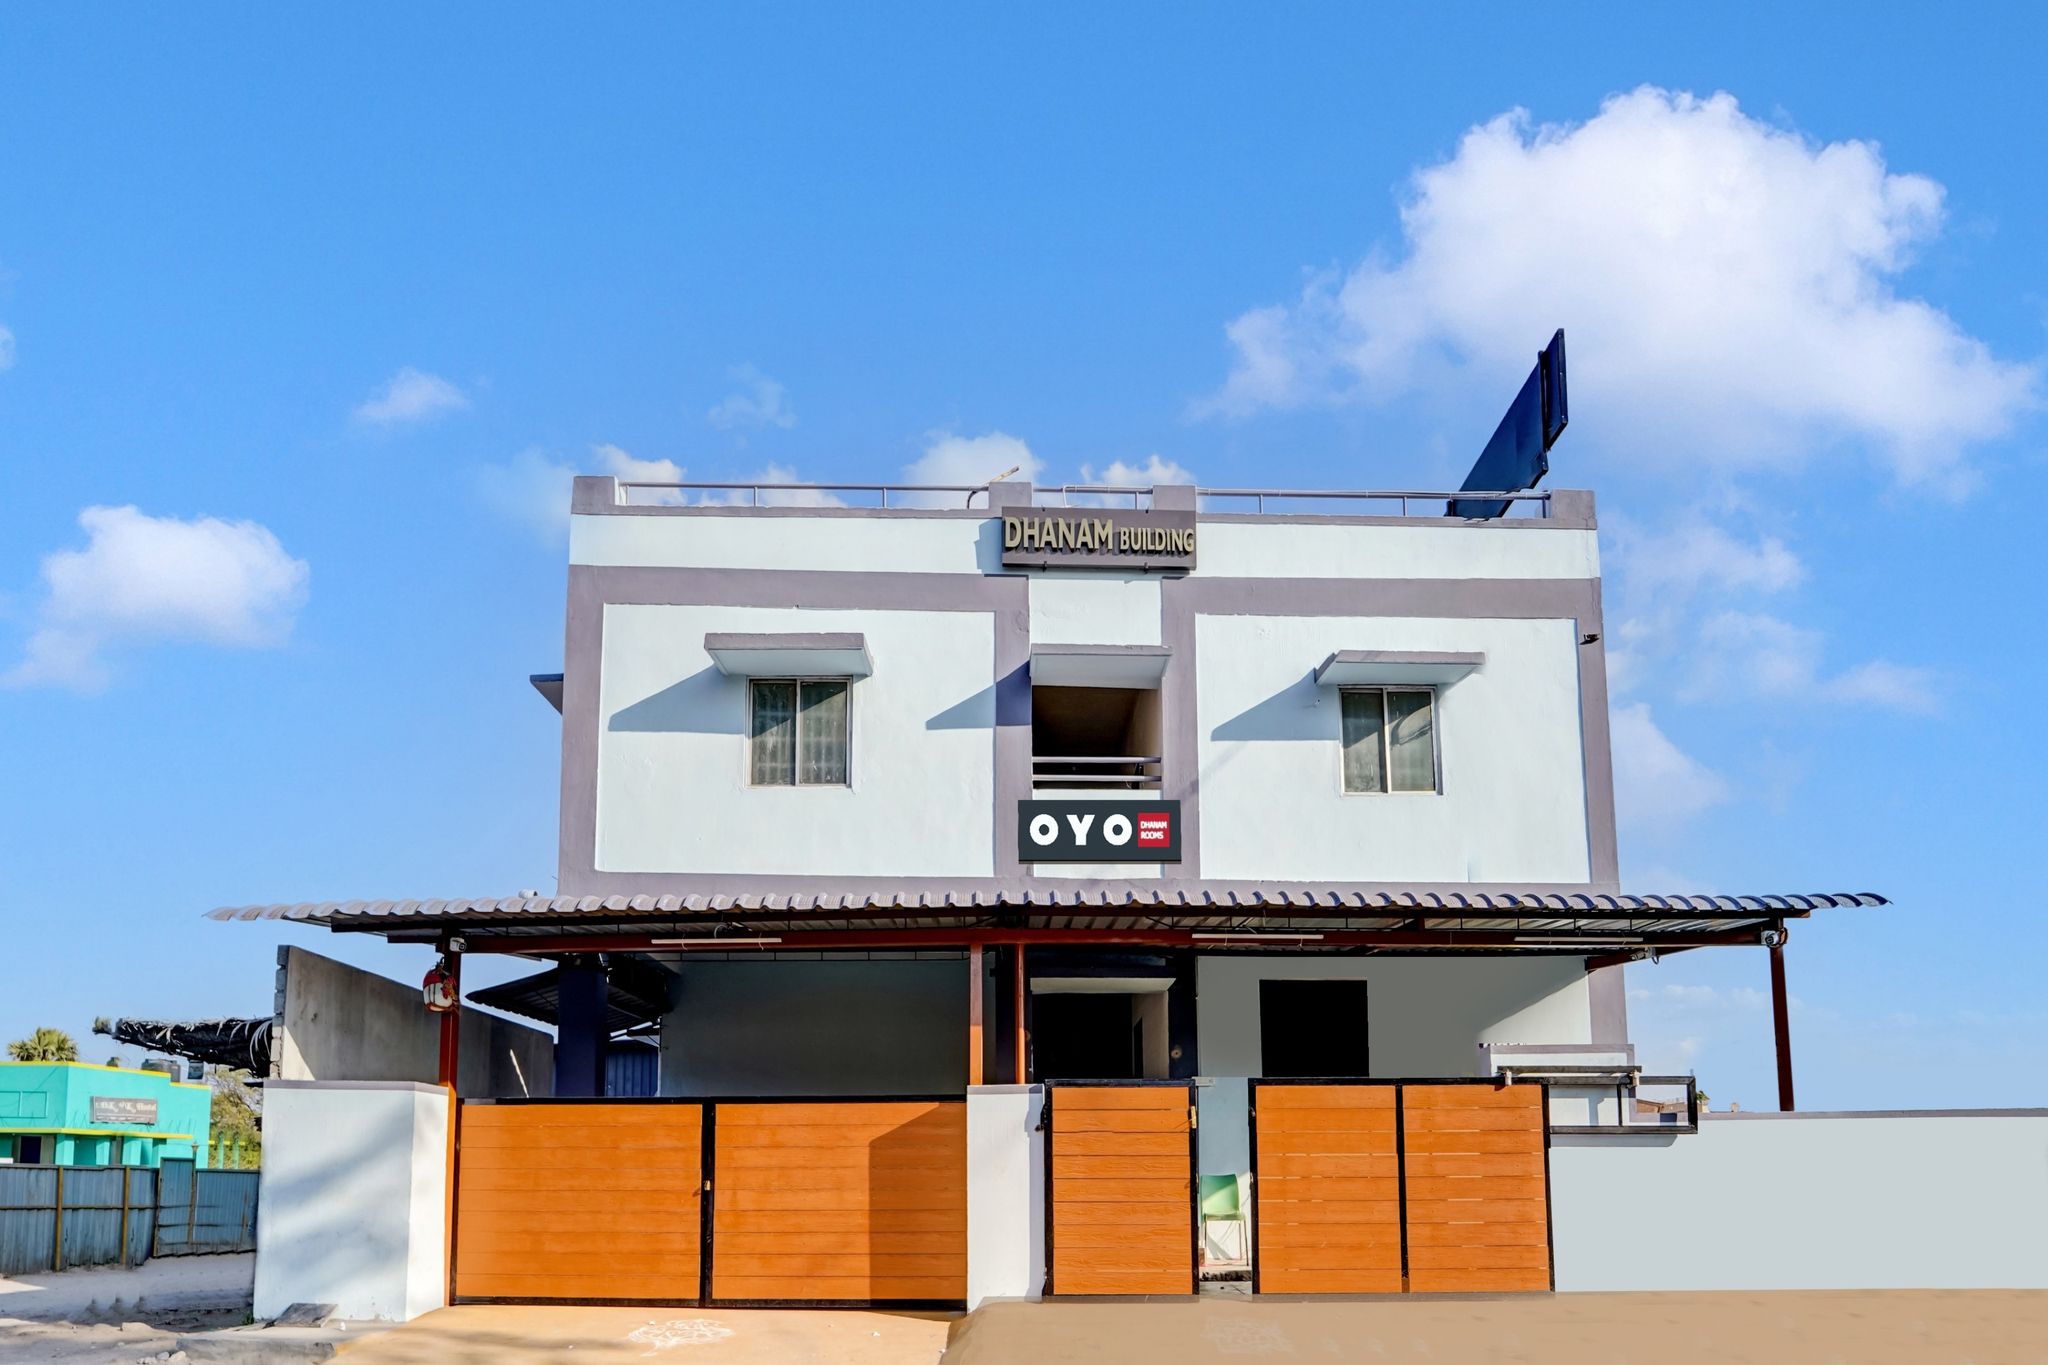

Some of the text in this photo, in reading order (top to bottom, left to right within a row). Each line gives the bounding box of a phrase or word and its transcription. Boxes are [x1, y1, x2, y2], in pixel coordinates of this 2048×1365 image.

[1004, 516, 1195, 552] DHANAM BUILDING
[1030, 813, 1132, 846] OYO
[1140, 831, 1164, 839] ROOMS
